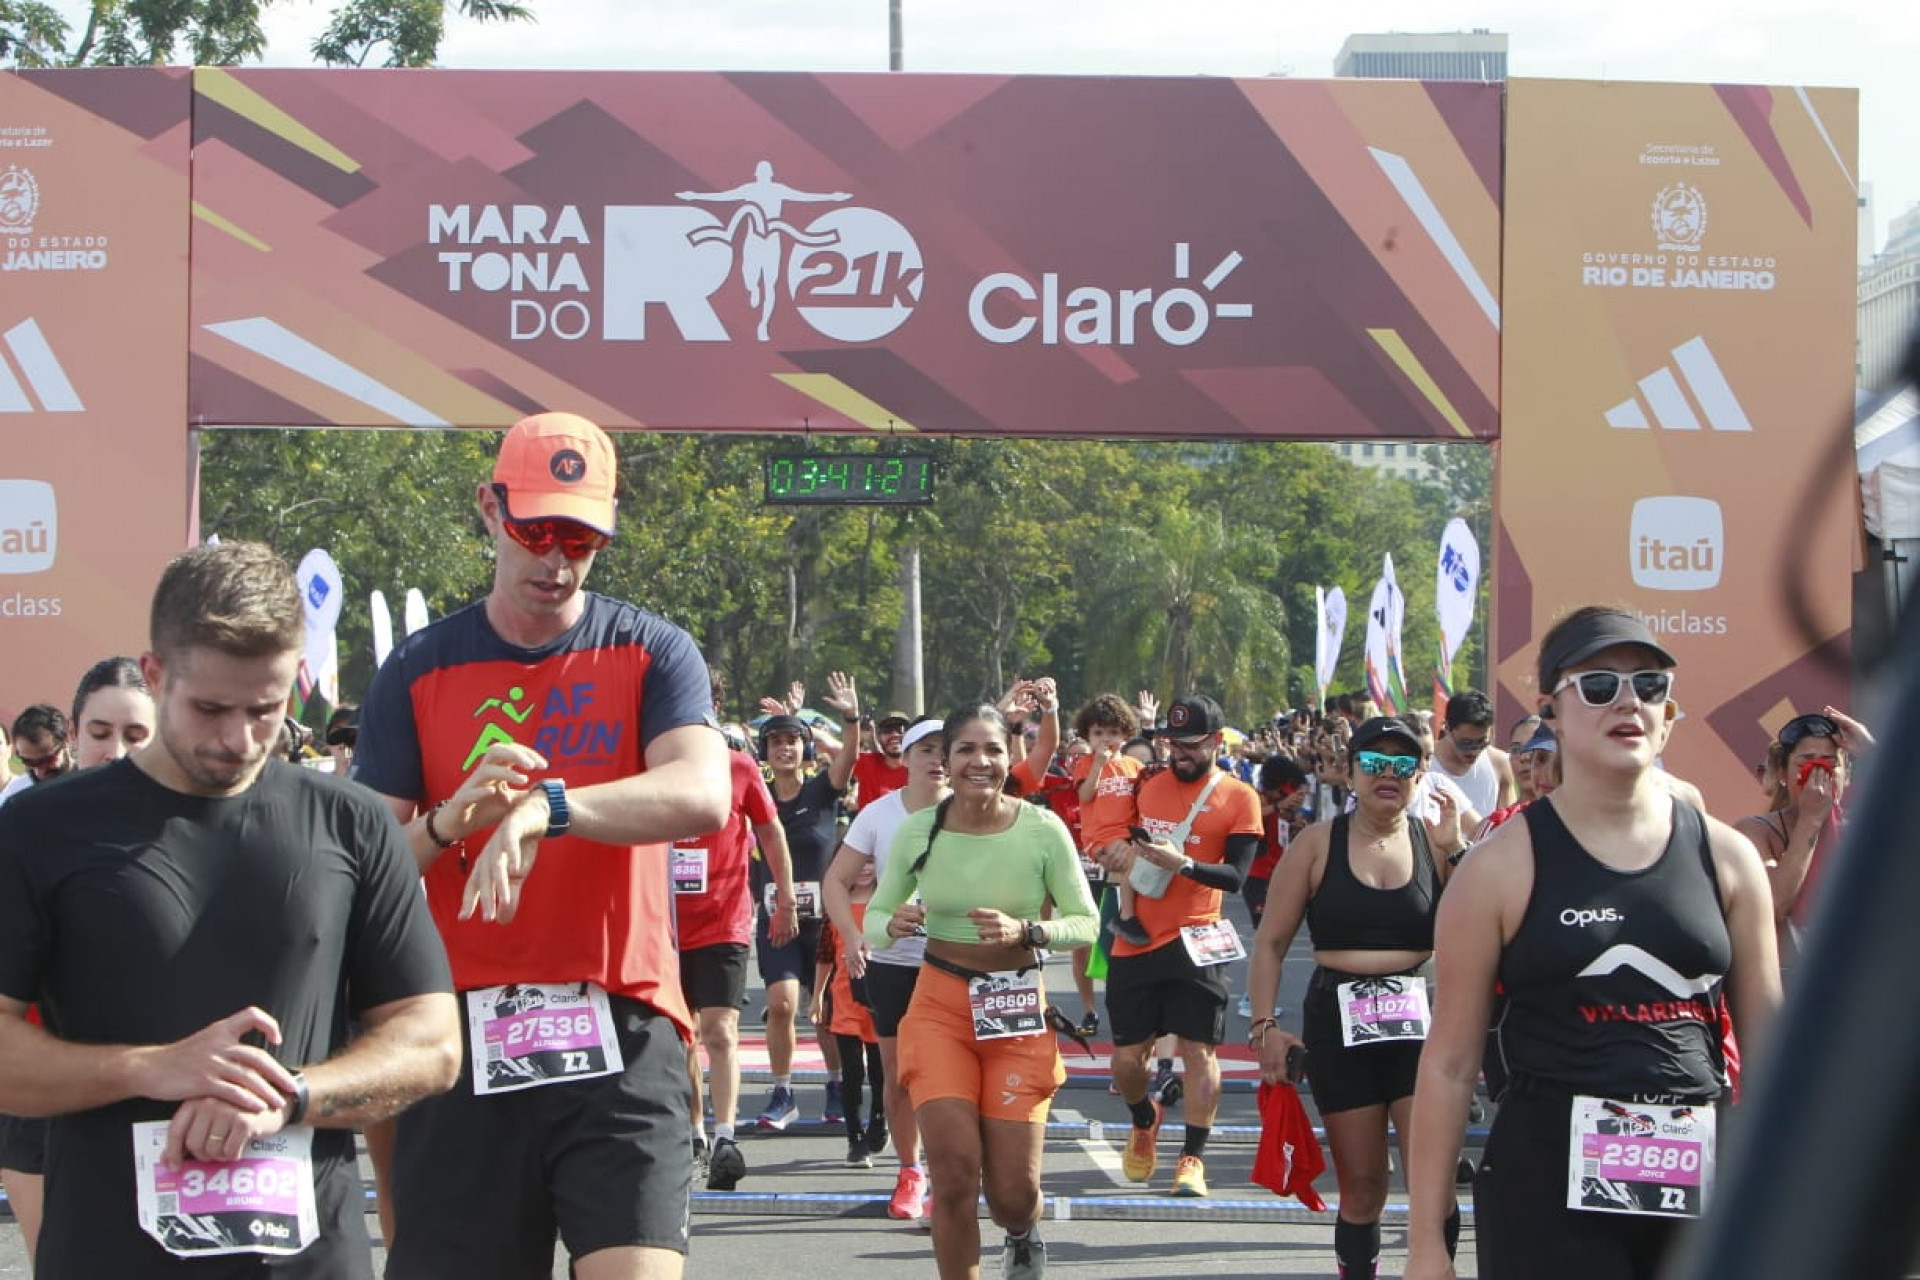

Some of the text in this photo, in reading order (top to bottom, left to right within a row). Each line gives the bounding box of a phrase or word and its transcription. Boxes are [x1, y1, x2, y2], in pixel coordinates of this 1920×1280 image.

[428, 204, 590, 244] MARA
[9, 236, 108, 248] DO ESTADO
[2, 250, 108, 270] JANEIRO
[439, 252, 590, 291] TONA
[1582, 252, 1777, 268] GOVERNO DO ESTADO
[1582, 266, 1775, 290] RIO DE JANEIRO
[510, 300, 590, 340] DO
[968, 272, 1209, 346] Claro
[772, 458, 928, 494] 03:41:21
[1639, 535, 1713, 571] itaú
[2, 592, 61, 616] class
[542, 683, 596, 720] AF
[534, 721, 623, 757] RUN
[1560, 907, 1625, 927] Opus.
[550, 992, 578, 1003] Claro
[984, 993, 1037, 1011] 26609
[506, 1014, 592, 1045] 27536
[1662, 1121, 1688, 1135] Claro
[250, 1139, 283, 1152] Claro
[1602, 1143, 1699, 1172] 23680
[181, 1166, 296, 1197] 34602
[1637, 1169, 1667, 1179] JOYCE
